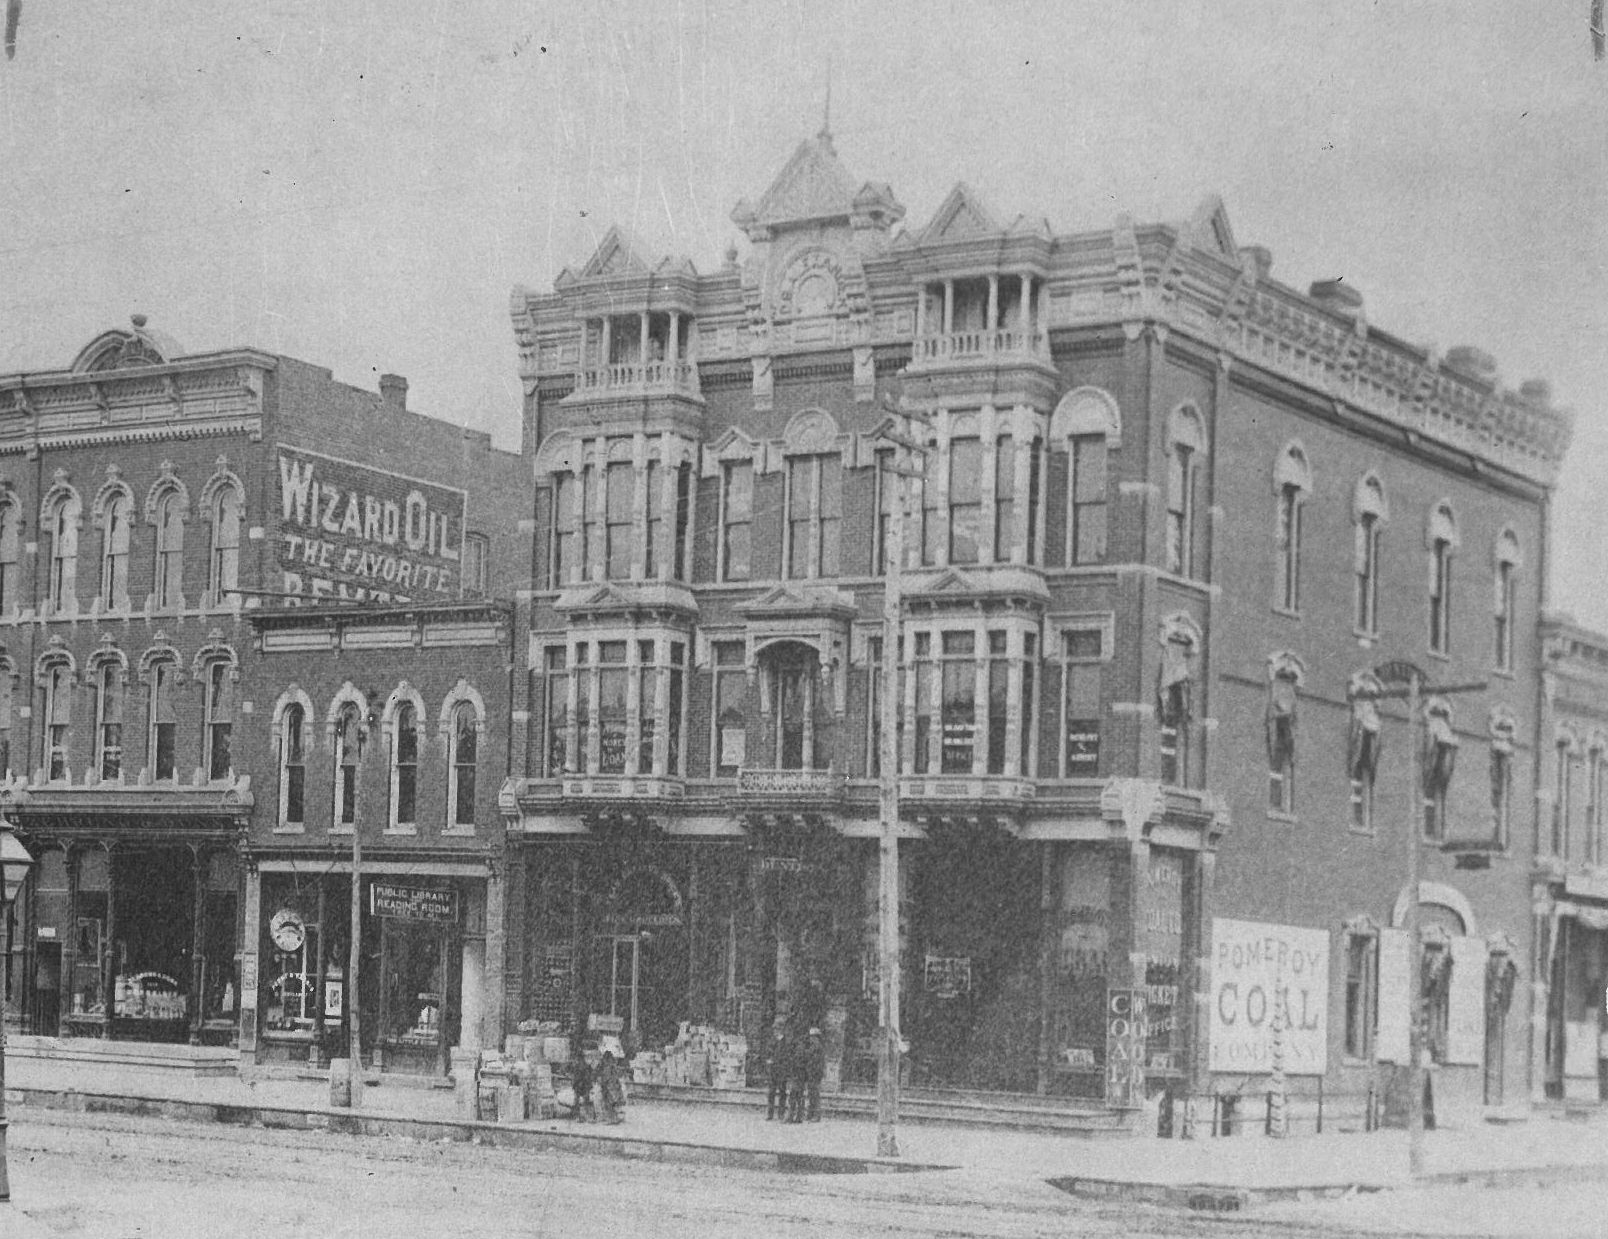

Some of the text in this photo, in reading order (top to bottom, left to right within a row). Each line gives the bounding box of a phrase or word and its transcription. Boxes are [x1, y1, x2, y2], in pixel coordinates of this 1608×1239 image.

[279, 456, 459, 560] WIZARD OIL
[285, 534, 450, 593] THE FAVORITE
[377, 887, 450, 902] PUBLIC LIBRARY
[377, 899, 418, 911] READING
[1219, 937, 1320, 975] POMEROY
[1218, 982, 1319, 1031] COAL
[1111, 995, 1130, 1083] COAL
